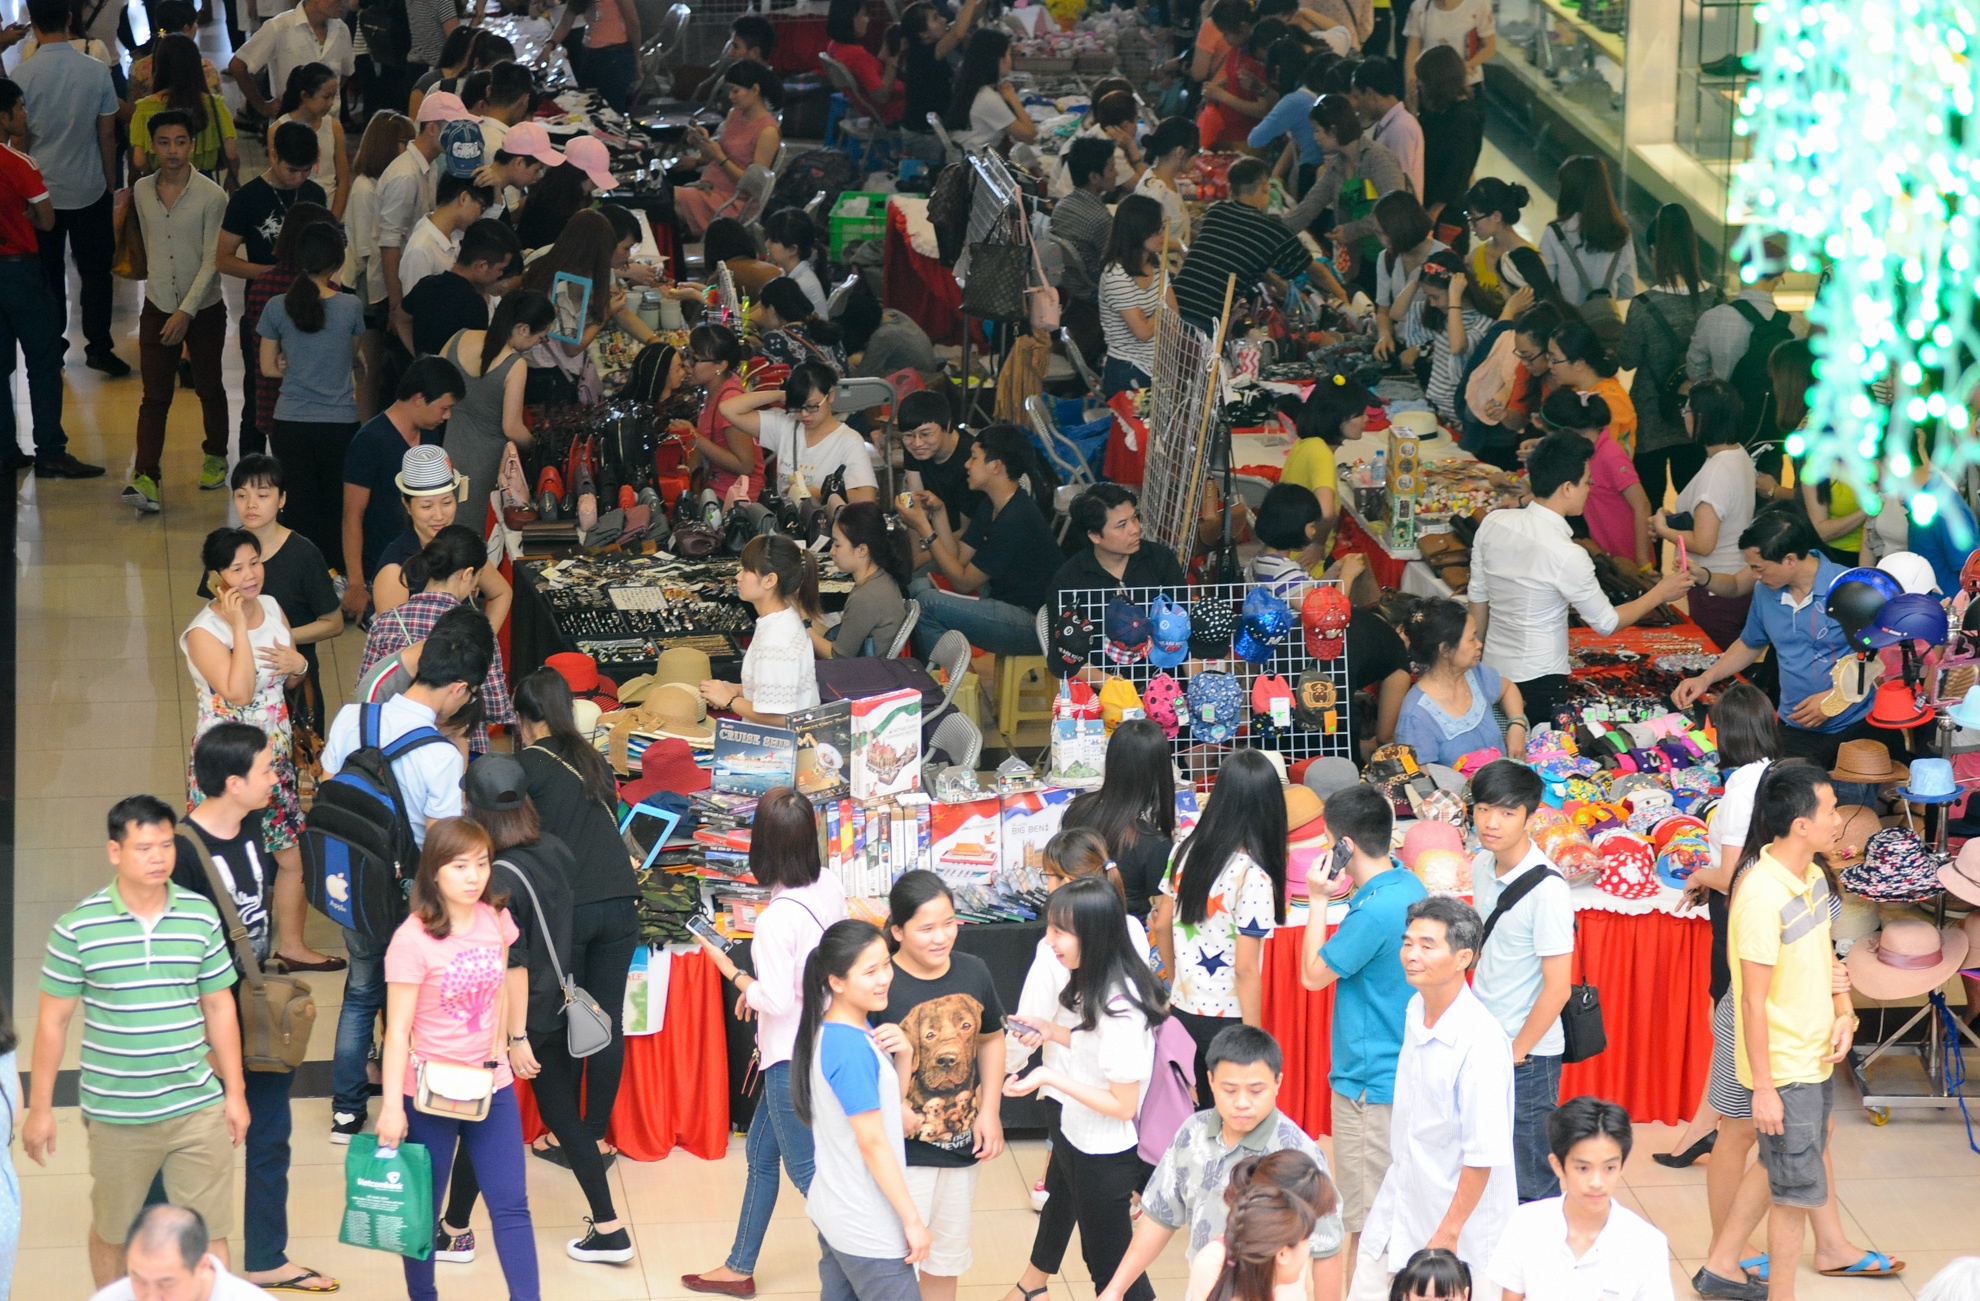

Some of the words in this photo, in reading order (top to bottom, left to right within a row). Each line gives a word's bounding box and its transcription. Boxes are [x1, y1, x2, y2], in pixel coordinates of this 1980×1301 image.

[719, 729, 761, 746] CRUISE
[763, 736, 791, 750] SHIP
[1012, 826, 1025, 835] BIG
[1028, 825, 1044, 834] BEN
